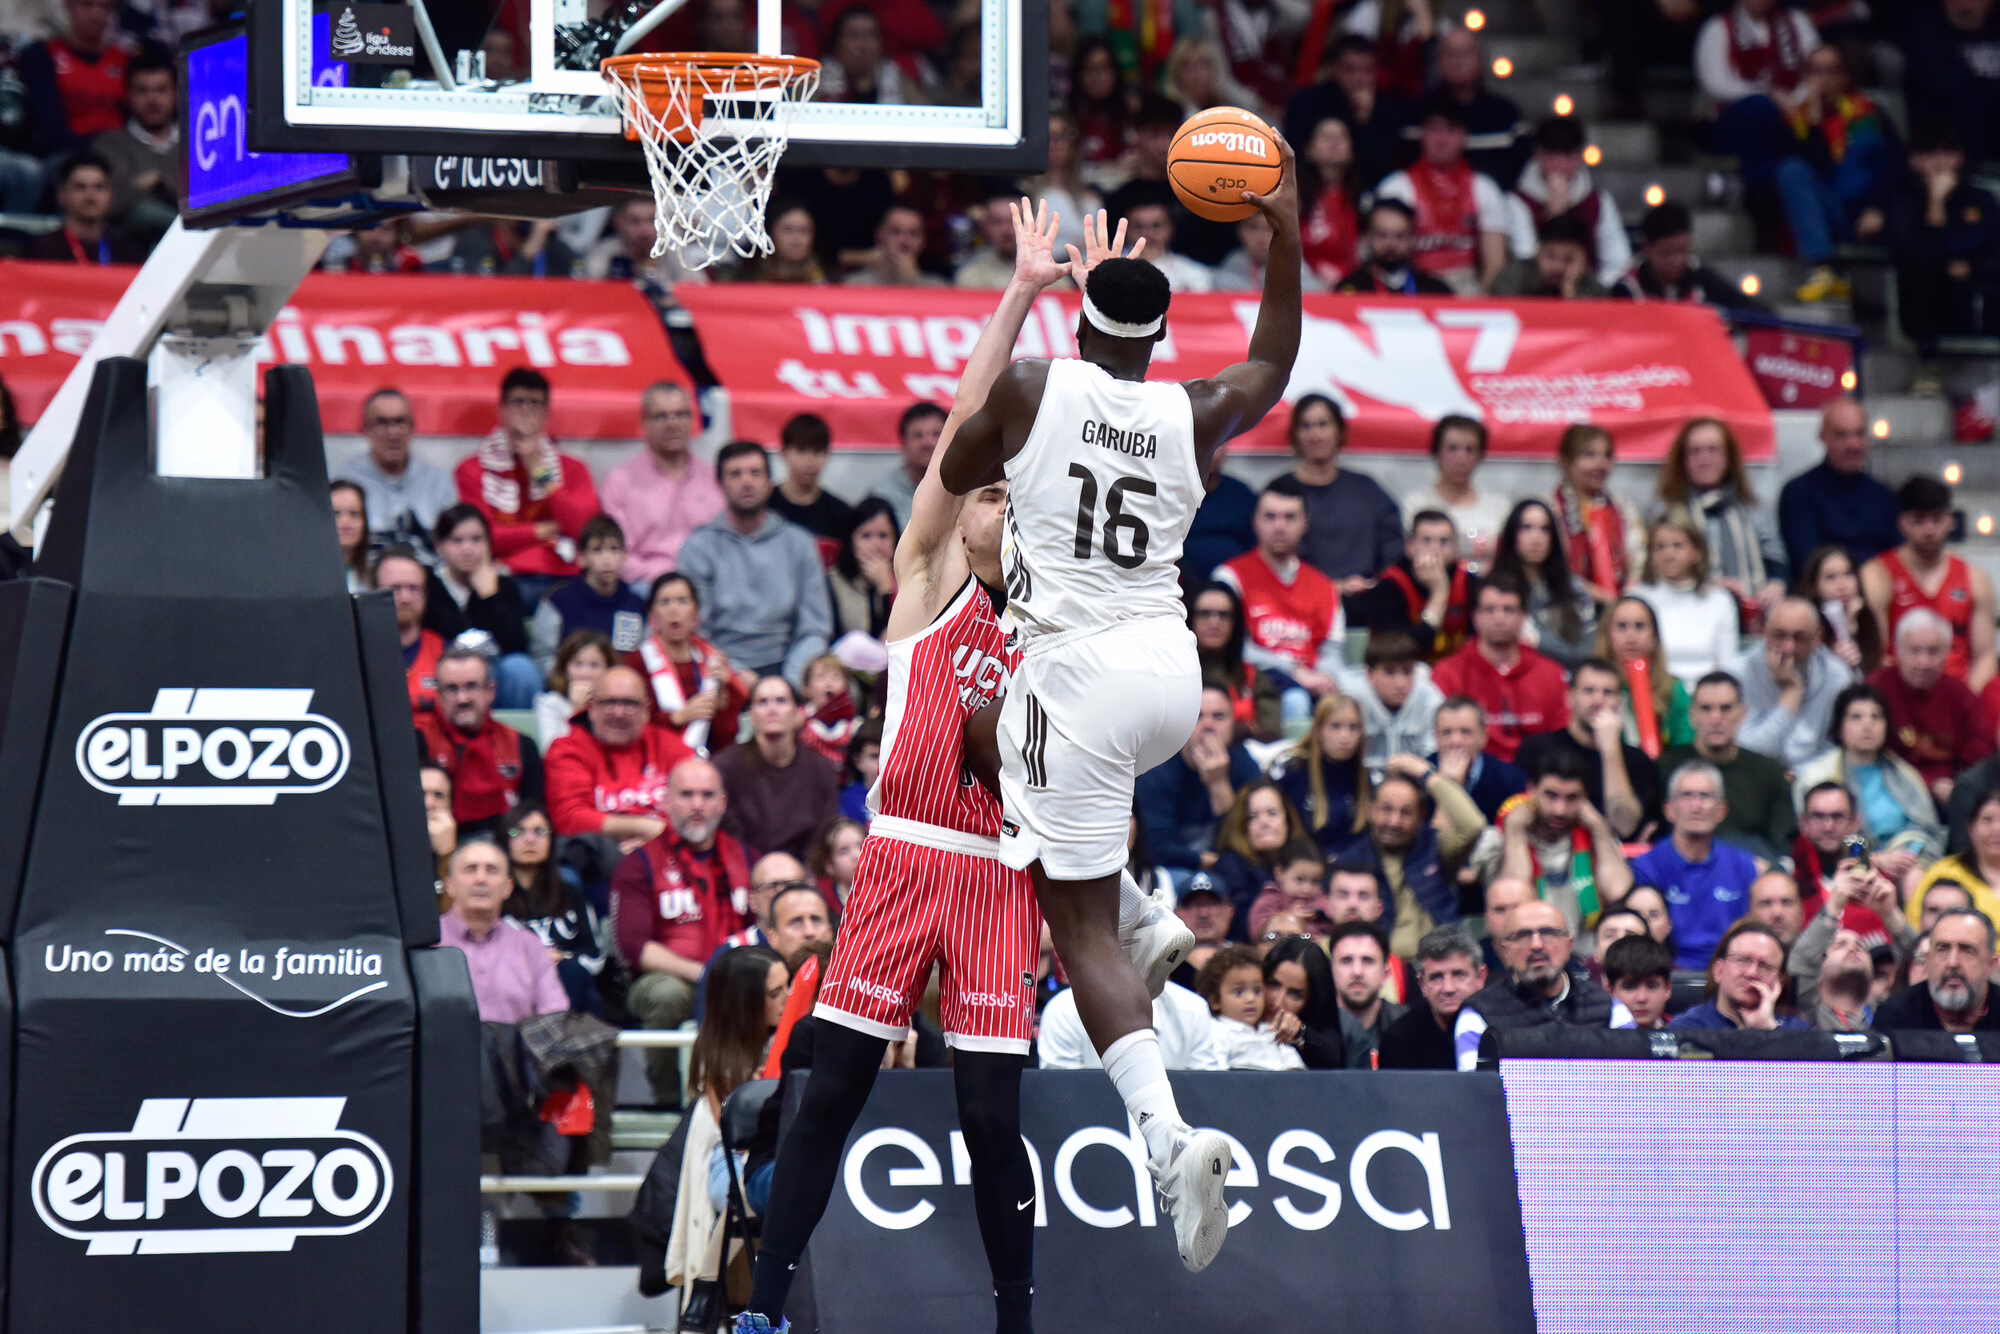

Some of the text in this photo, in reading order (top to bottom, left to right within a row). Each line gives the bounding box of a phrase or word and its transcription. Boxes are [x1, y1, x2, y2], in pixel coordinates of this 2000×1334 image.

[366, 44, 414, 57] endesa
[1191, 132, 1266, 158] Wilson
[1215, 177, 1247, 189] acb
[778, 358, 888, 398] tu
[1081, 419, 1158, 460] GARUBA
[1068, 461, 1157, 569] 16
[45, 944, 383, 981] Uno más de la familia
[842, 1106, 1452, 1231] edsa
